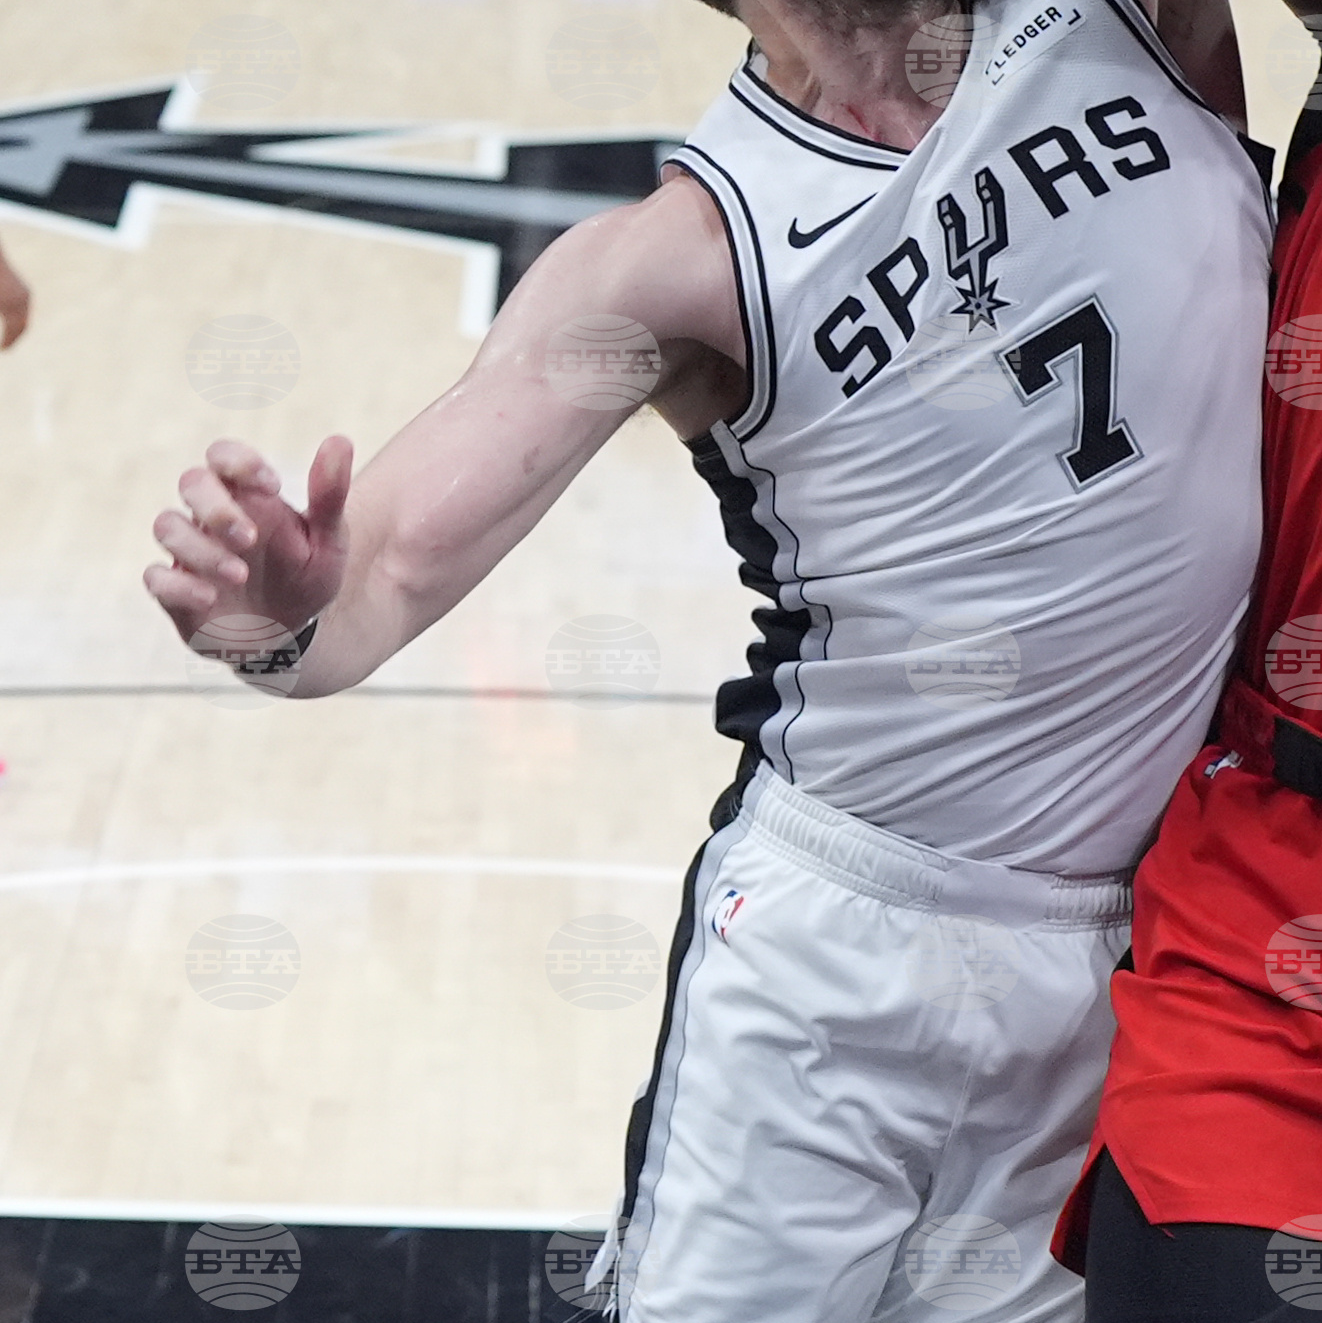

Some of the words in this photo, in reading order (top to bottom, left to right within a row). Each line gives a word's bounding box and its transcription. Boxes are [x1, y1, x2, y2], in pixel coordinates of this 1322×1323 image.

[994, 5, 1063, 69] LEDGER
[813, 95, 1172, 400] SPURS
[995, 293, 1145, 495] 7
